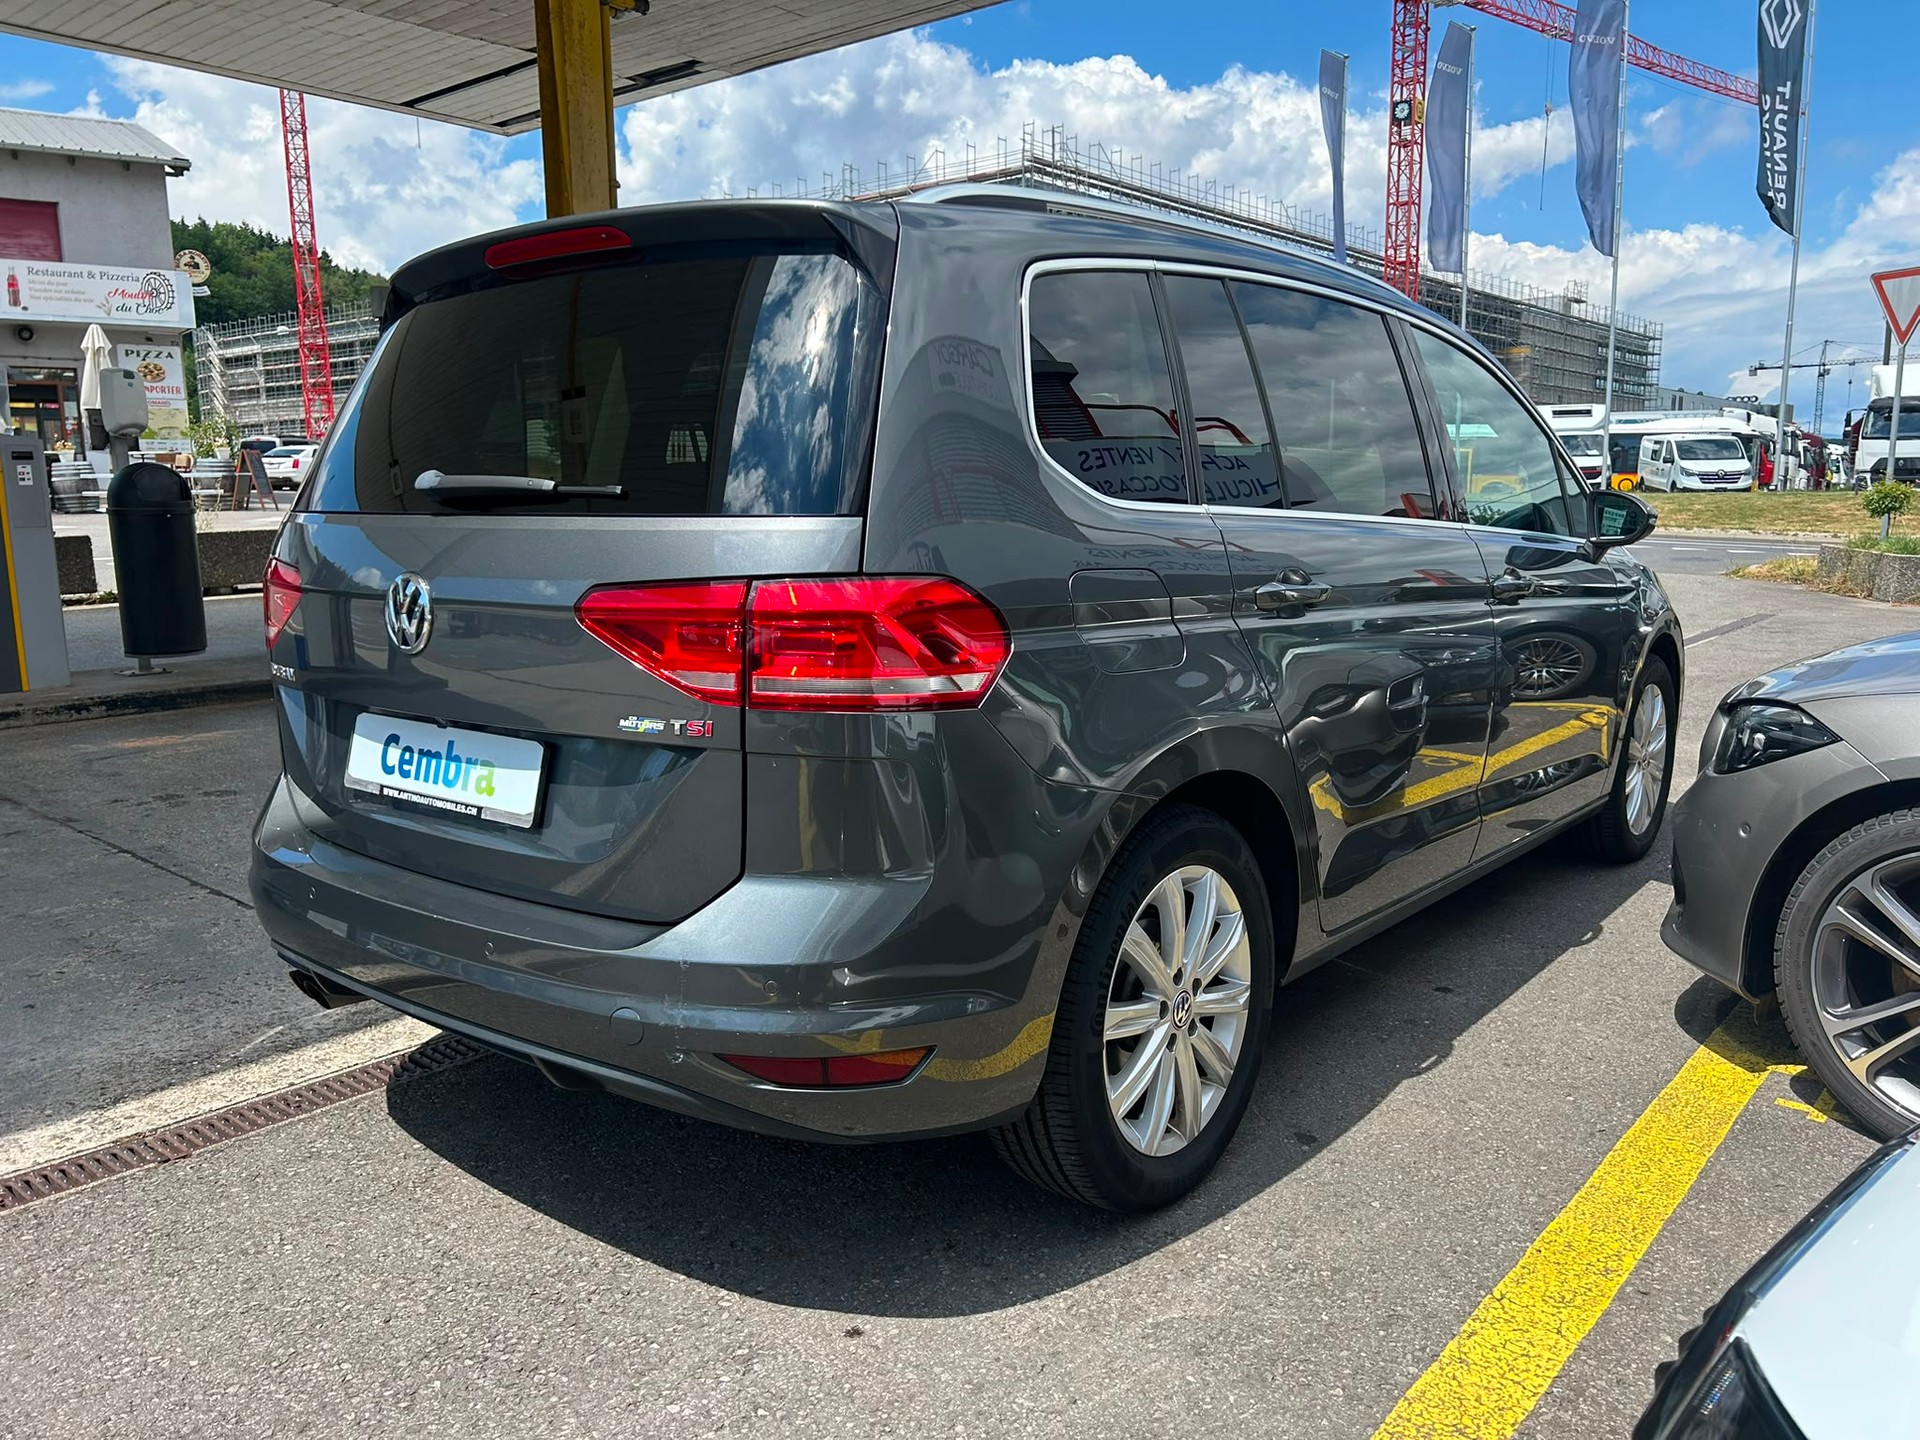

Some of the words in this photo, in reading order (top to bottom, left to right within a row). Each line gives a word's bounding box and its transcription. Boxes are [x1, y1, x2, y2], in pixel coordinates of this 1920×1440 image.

[27, 266, 84, 279] Restaurant
[86, 270, 96, 280] &
[99, 270, 141, 282] Pizzeria
[107, 288, 154, 300] Moulin
[115, 302, 132, 313] du
[124, 349, 174, 361] PIZZA
[144, 385, 182, 395] MPORTER
[619, 719, 665, 731] MOTORS
[670, 719, 714, 737] TSI
[381, 733, 496, 797] Cembra
[382, 787, 478, 816] WWW.ANTHOAUTOMOBILES.CH
